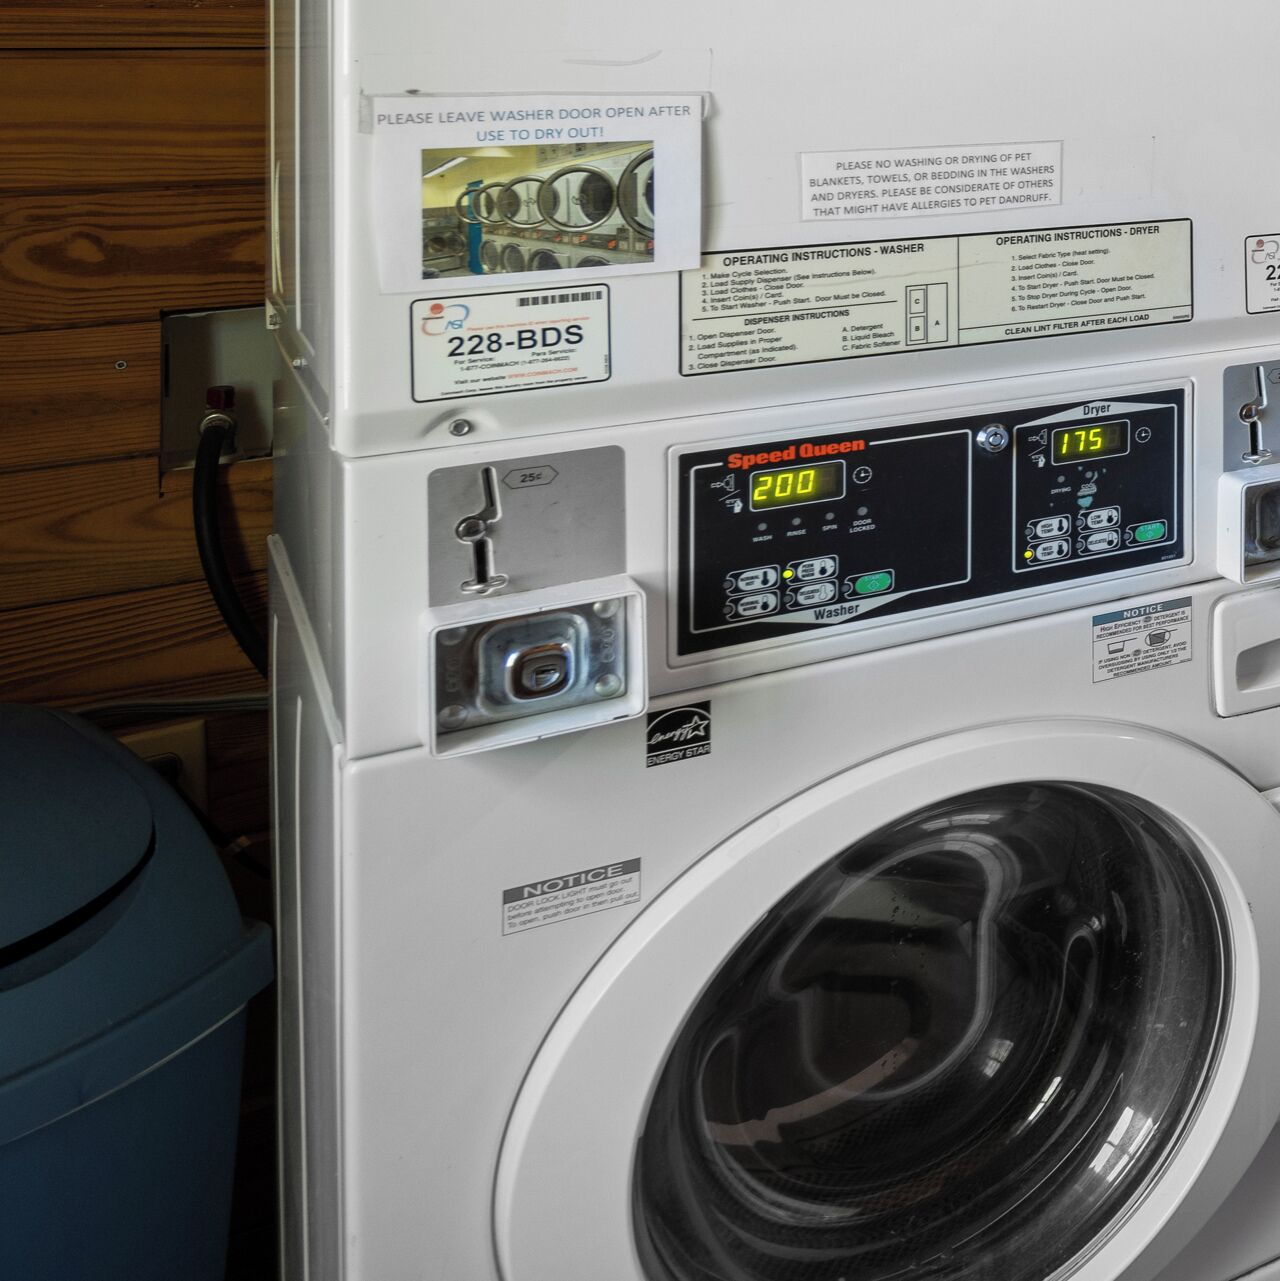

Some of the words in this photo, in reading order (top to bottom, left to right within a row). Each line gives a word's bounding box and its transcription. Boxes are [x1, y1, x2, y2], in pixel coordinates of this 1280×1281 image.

[377, 113, 433, 125] PLEASE
[439, 111, 485, 124] LEAVE
[490, 109, 554, 122] WASHER
[559, 108, 602, 120] DOOR
[606, 107, 644, 118] OPEN
[648, 106, 690, 117] AFTER
[477, 130, 505, 142] USE
[509, 130, 530, 140] TO
[535, 128, 563, 140] DRY
[568, 127, 603, 139] OUT!
[836, 161, 872, 171] PLEASE
[876, 160, 891, 169] NO
[894, 157, 942, 168] WASHING
[945, 156, 959, 165] OR
[962, 154, 998, 164] DRYING
[1000, 154, 1012, 162] OF
[1015, 153, 1032, 162] PET
[810, 176, 864, 188] BLANKETS,
[867, 173, 911, 184] TOWELS,
[914, 172, 928, 182] OR
[931, 170, 975, 181] BEDDING
[978, 169, 987, 177] IN
[990, 168, 1008, 177] THE
[1010, 165, 1055, 176] WASHERS
[811, 192, 834, 202] AND
[837, 190, 878, 201] DRYERS.
[882, 187, 917, 198] PLEASE
[920, 186, 932, 196] BE
[934, 182, 1000, 195] CONSIDERATE
[1003, 182, 1015, 190] OF
[1018, 179, 1054, 190] OTHERS
[813, 207, 841, 217] THAT
[844, 204, 879, 215] MIGHT
[882, 202, 908, 212] HAVE
[911, 199, 962, 210] ALLERGIES
[964, 198, 977, 207] TO
[980, 197, 996, 206] PET
[999, 193, 1051, 205] DANDRUFF.
[996, 234, 1052, 246] OPERATING
[1054, 228, 1122, 242] INSTRUCTIONS
[1130, 226, 1160, 236] DRYER
[723, 253, 788, 267] OPERATING
[792, 247, 872, 262] INSTRUCTIONS
[880, 243, 924, 255] WASHER
[744, 315, 790, 326] DISPENSER
[792, 309, 850, 322] INSTRUCTIONS
[1005, 326, 1032, 335] CLEAN
[1034, 324, 1051, 333] LINT
[1053, 322, 1079, 331] FILTER
[1080, 319, 1105, 328] AFTER
[1107, 316, 1127, 325] EACH
[1129, 313, 1150, 322] LOAD
[448, 324, 584, 357] 228-BDS
[1083, 403, 1111, 416] Dryer
[1062, 429, 1101, 454] 175
[728, 446, 796, 470] Speed
[800, 440, 865, 458] Queen
[754, 470, 814, 501] 200
[814, 603, 860, 620] Washer
[1124, 604, 1163, 618] NOTICE
[647, 750, 684, 765] ENERGY
[687, 744, 710, 757] STAR
[523, 864, 623, 898] NOTICE
